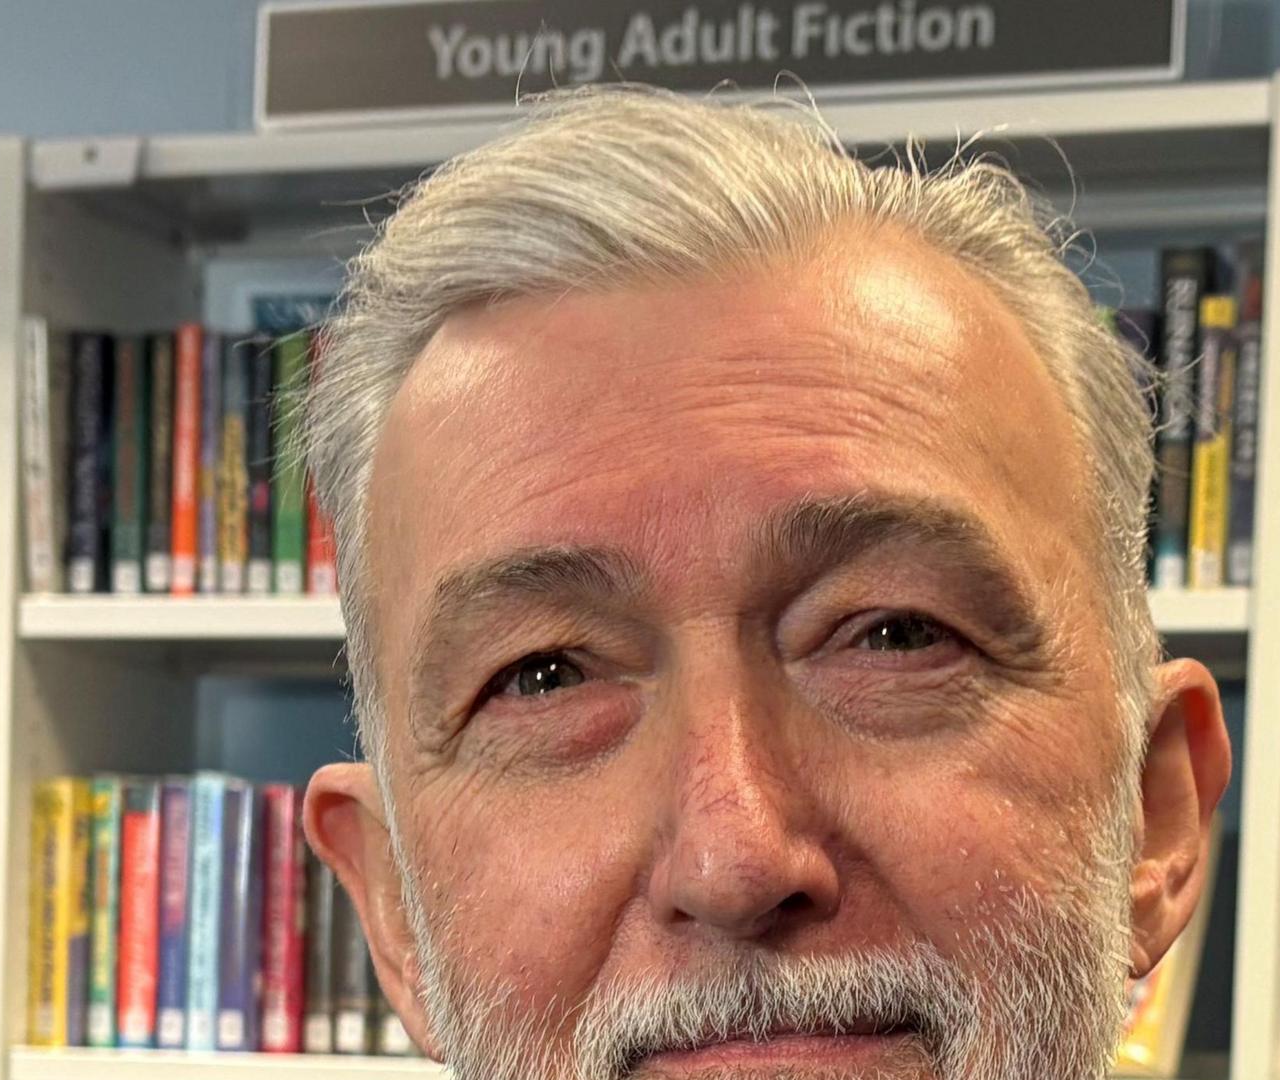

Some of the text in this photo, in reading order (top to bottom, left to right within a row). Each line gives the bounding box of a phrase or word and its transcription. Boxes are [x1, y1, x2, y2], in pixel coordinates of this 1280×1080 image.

[428, 0, 996, 81] Young Adult Fiction
